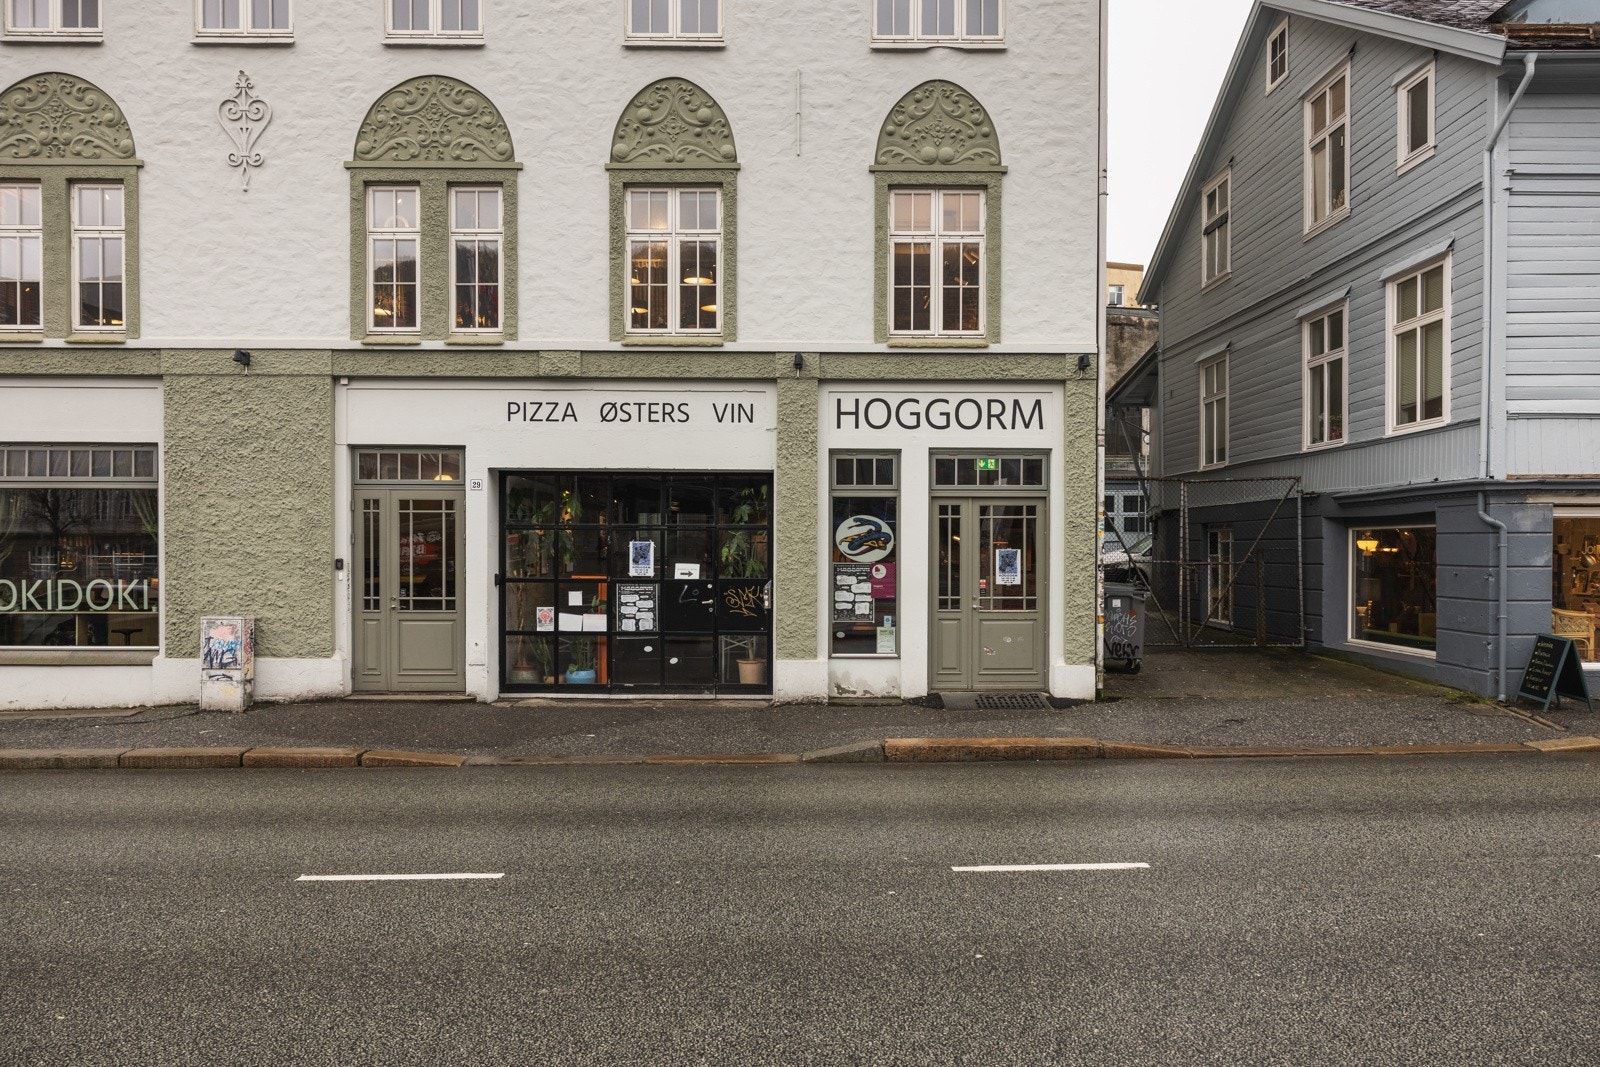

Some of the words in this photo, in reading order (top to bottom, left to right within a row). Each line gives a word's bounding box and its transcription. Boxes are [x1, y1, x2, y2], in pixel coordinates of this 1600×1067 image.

[507, 402, 578, 423] PIZZA
[600, 402, 690, 423] ØSTERS
[713, 403, 754, 423] VIN
[836, 398, 1044, 430] HOGGORM
[472, 481, 481, 489] 29
[0, 578, 149, 611] OKIDOKI
